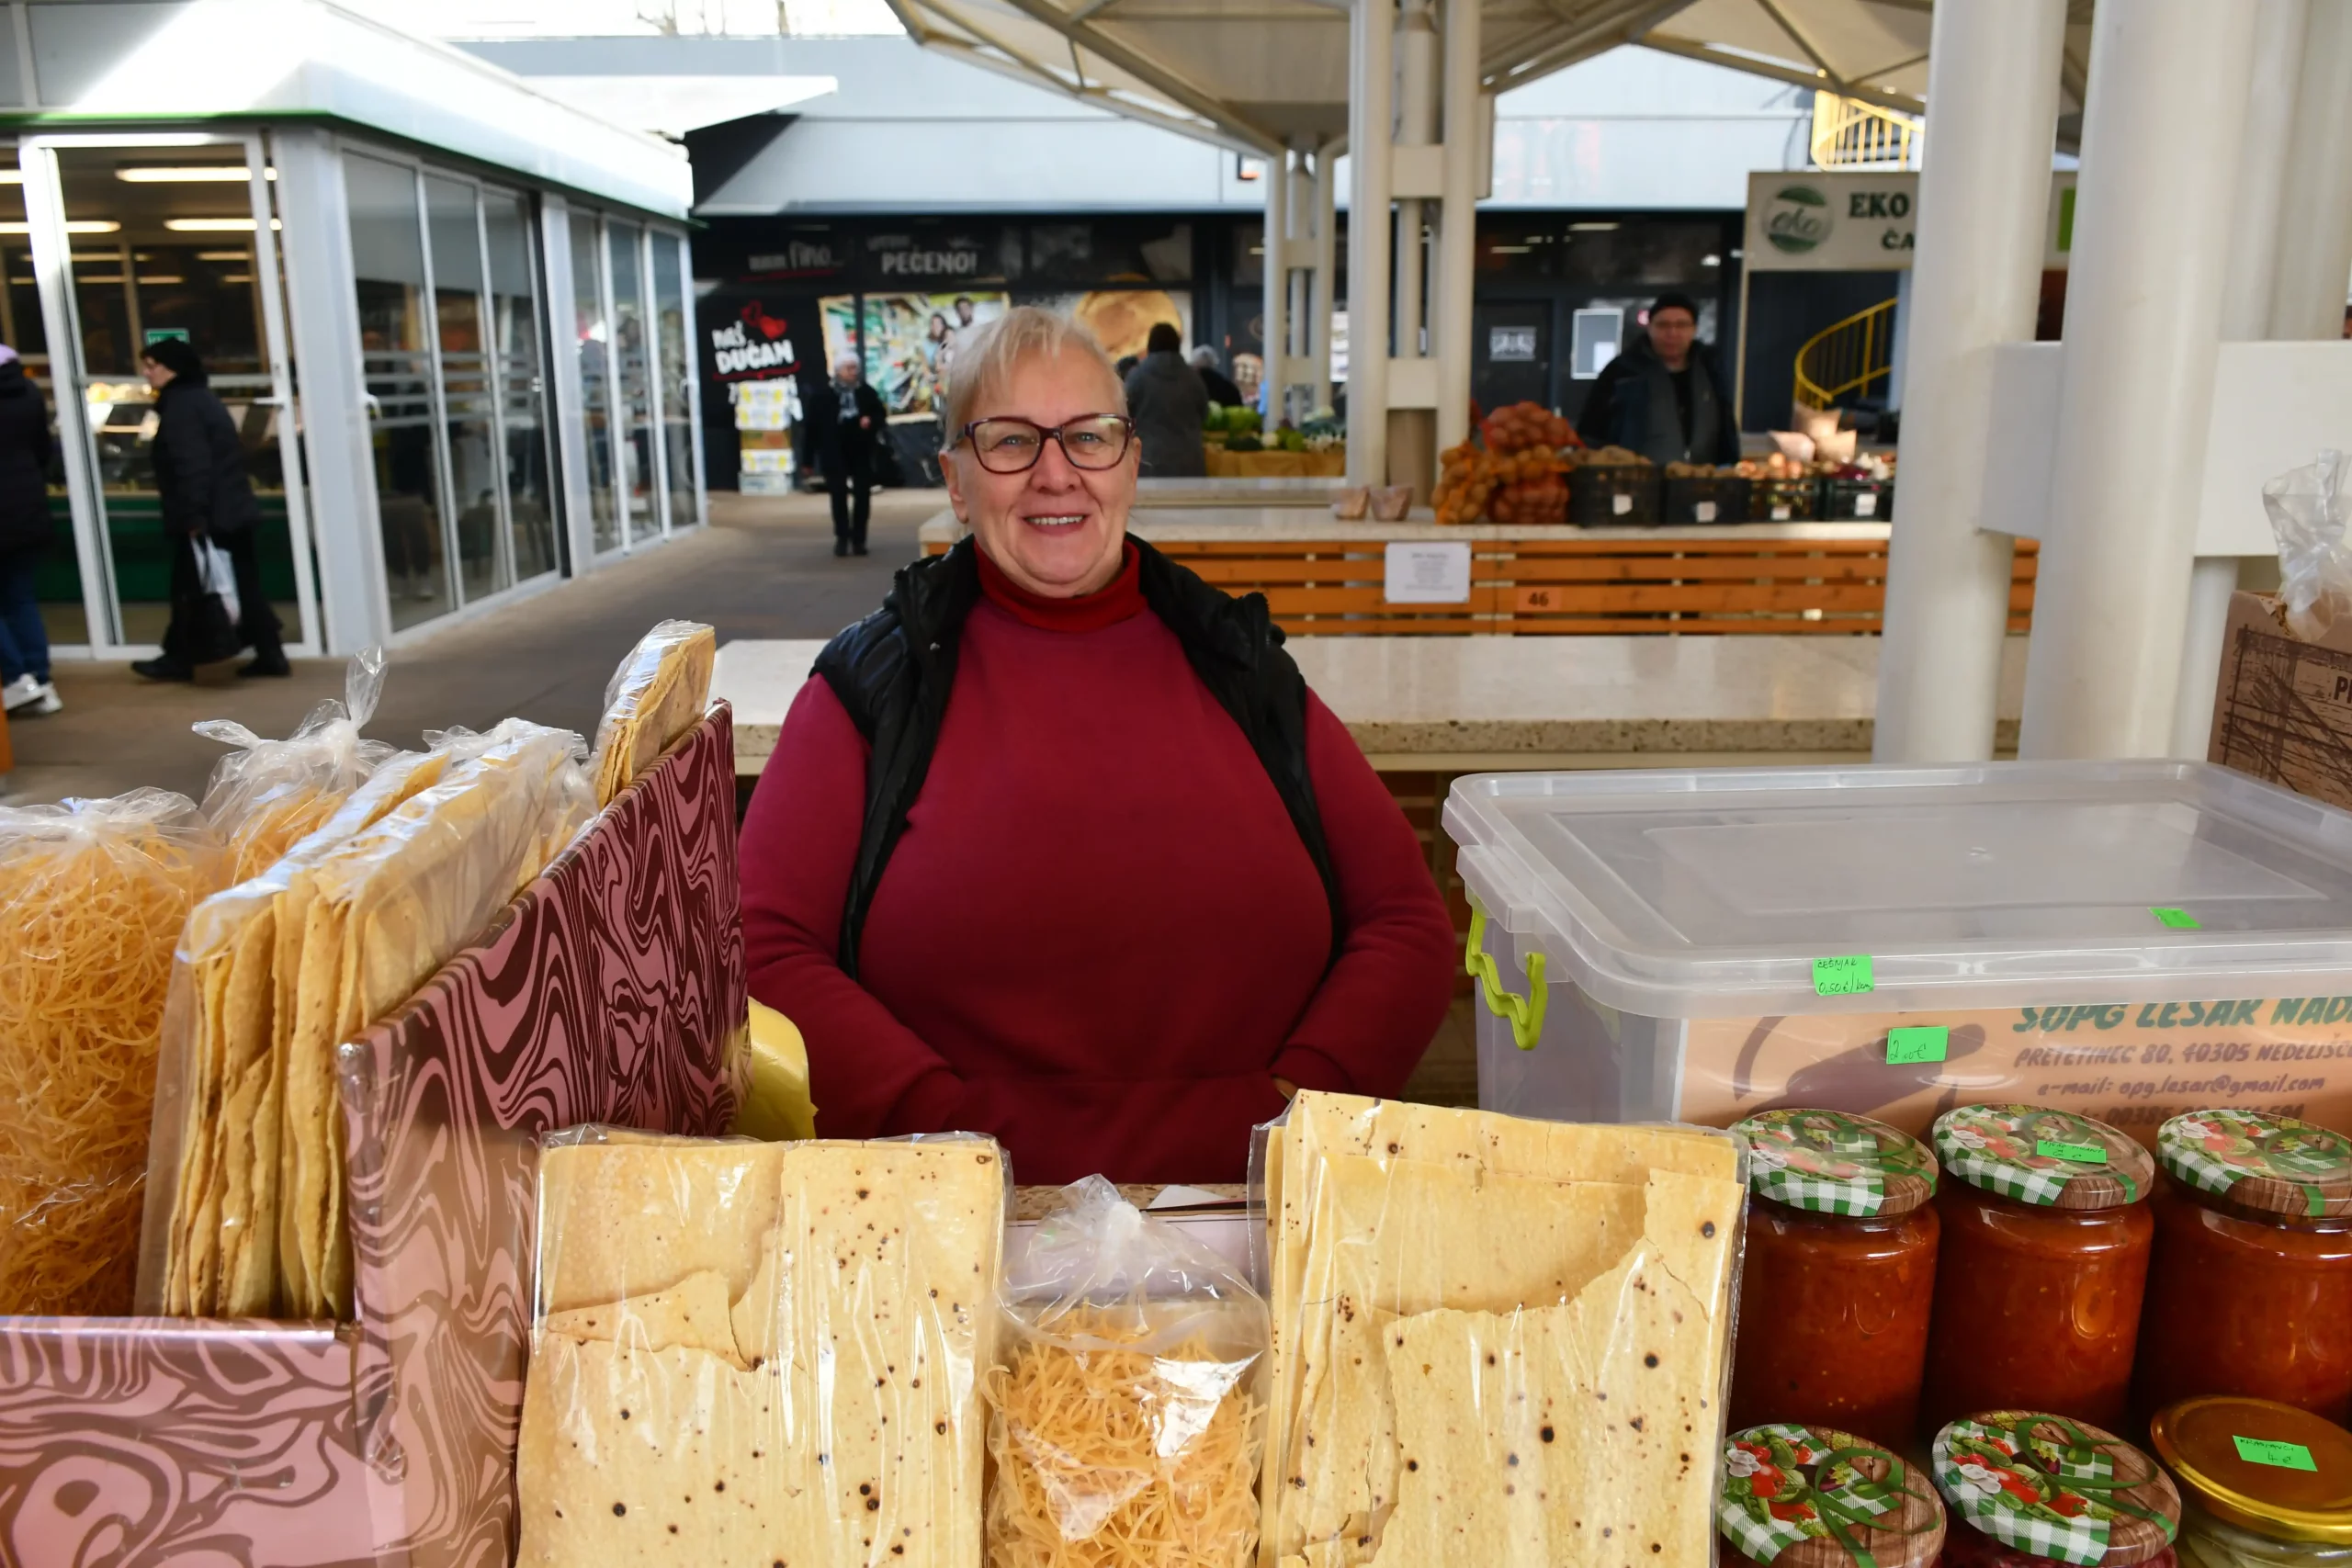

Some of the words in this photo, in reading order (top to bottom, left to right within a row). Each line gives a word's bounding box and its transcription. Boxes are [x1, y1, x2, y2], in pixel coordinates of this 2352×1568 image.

[1849, 191, 1910, 220] EKO
[1881, 227, 1915, 251] ČA
[1528, 592, 1549, 607] 46
[2012, 1003, 2129, 1032] SOPG
[2183, 1043, 2251, 1063] 40305
[2037, 1077, 2114, 1096] e-mail:
[2119, 1073, 2325, 1100] opg.lesar@gmail.com
